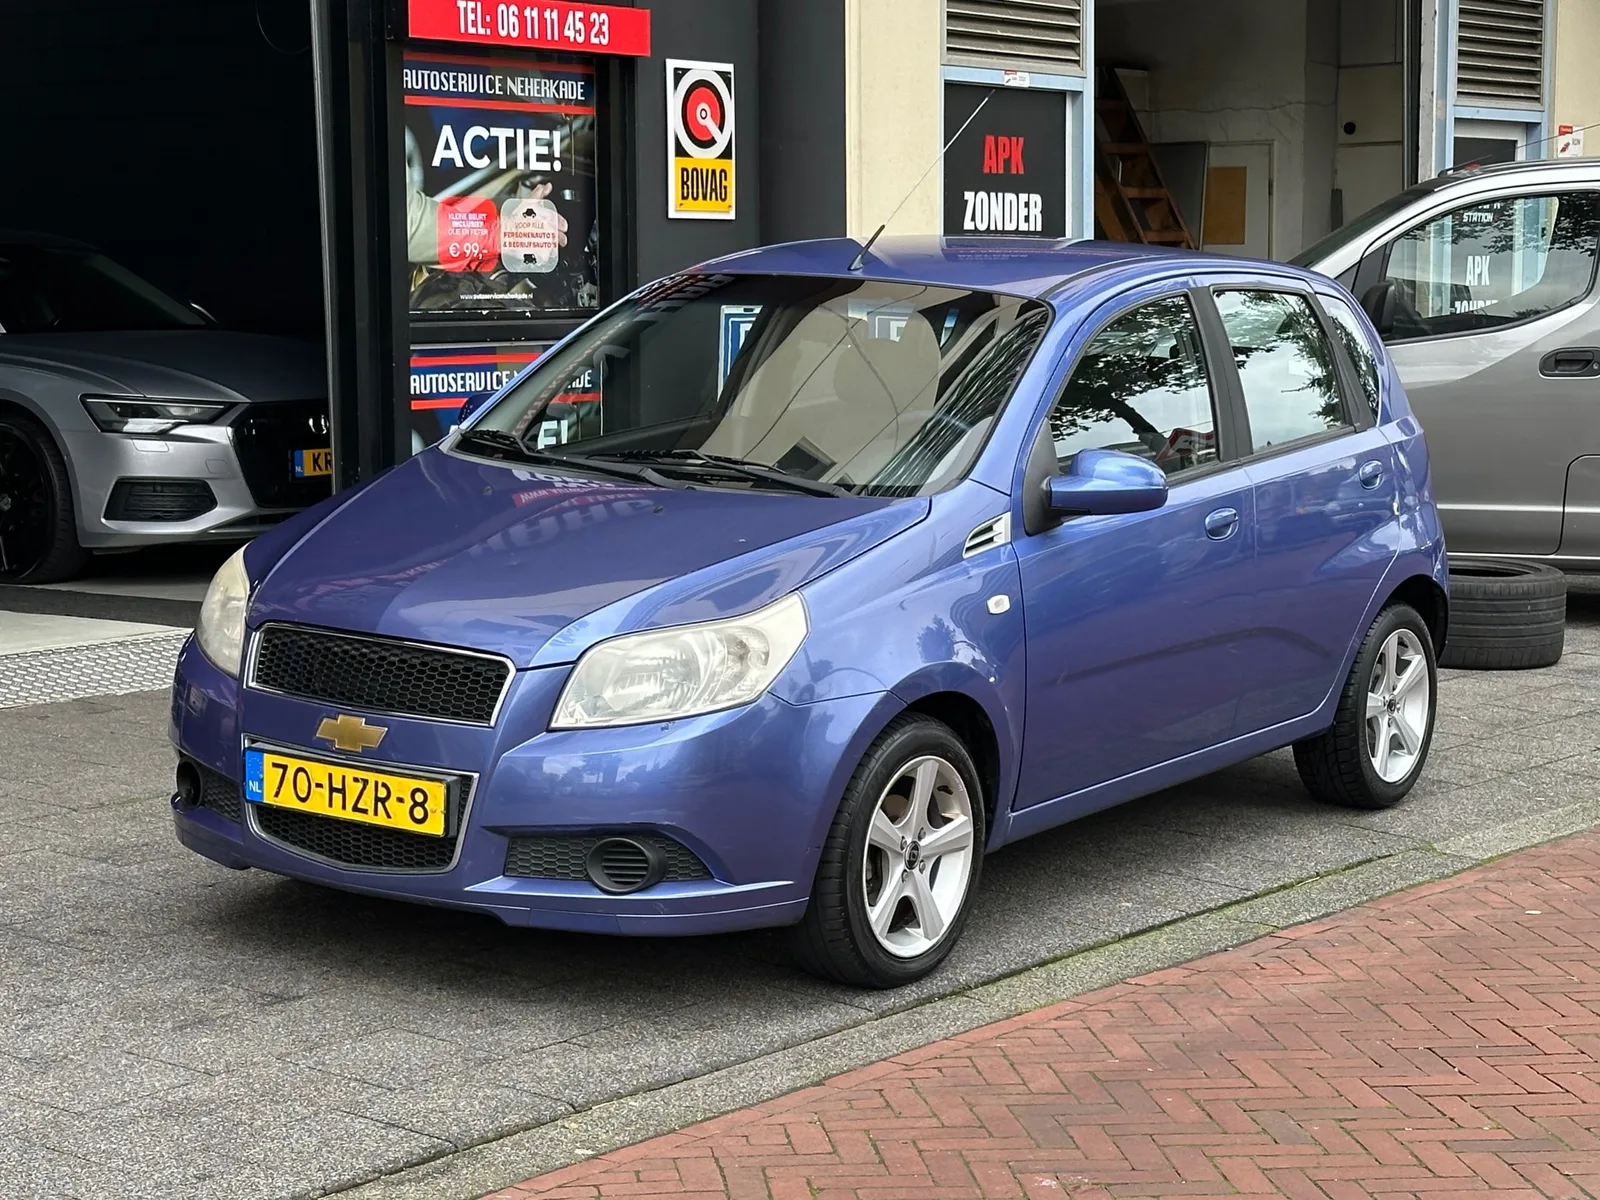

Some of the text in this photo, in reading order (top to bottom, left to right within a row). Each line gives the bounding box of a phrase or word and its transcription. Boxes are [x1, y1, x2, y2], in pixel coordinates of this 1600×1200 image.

[457, 0, 610, 45] TEL: 06 11 11 45 23
[403, 68, 586, 100] AUTOSERVICE NEHERKADE
[432, 124, 562, 172] ACTIE!
[982, 134, 1025, 175] APK
[680, 166, 728, 203] BOVAG
[963, 190, 1043, 232] ZONDER
[1462, 211, 1494, 223] STATION
[449, 243, 488, 259] € 99,-
[1466, 255, 1490, 286] APK
[410, 370, 510, 395] AUTOSERVICE
[249, 762, 429, 825] NL 70-HZR-8
